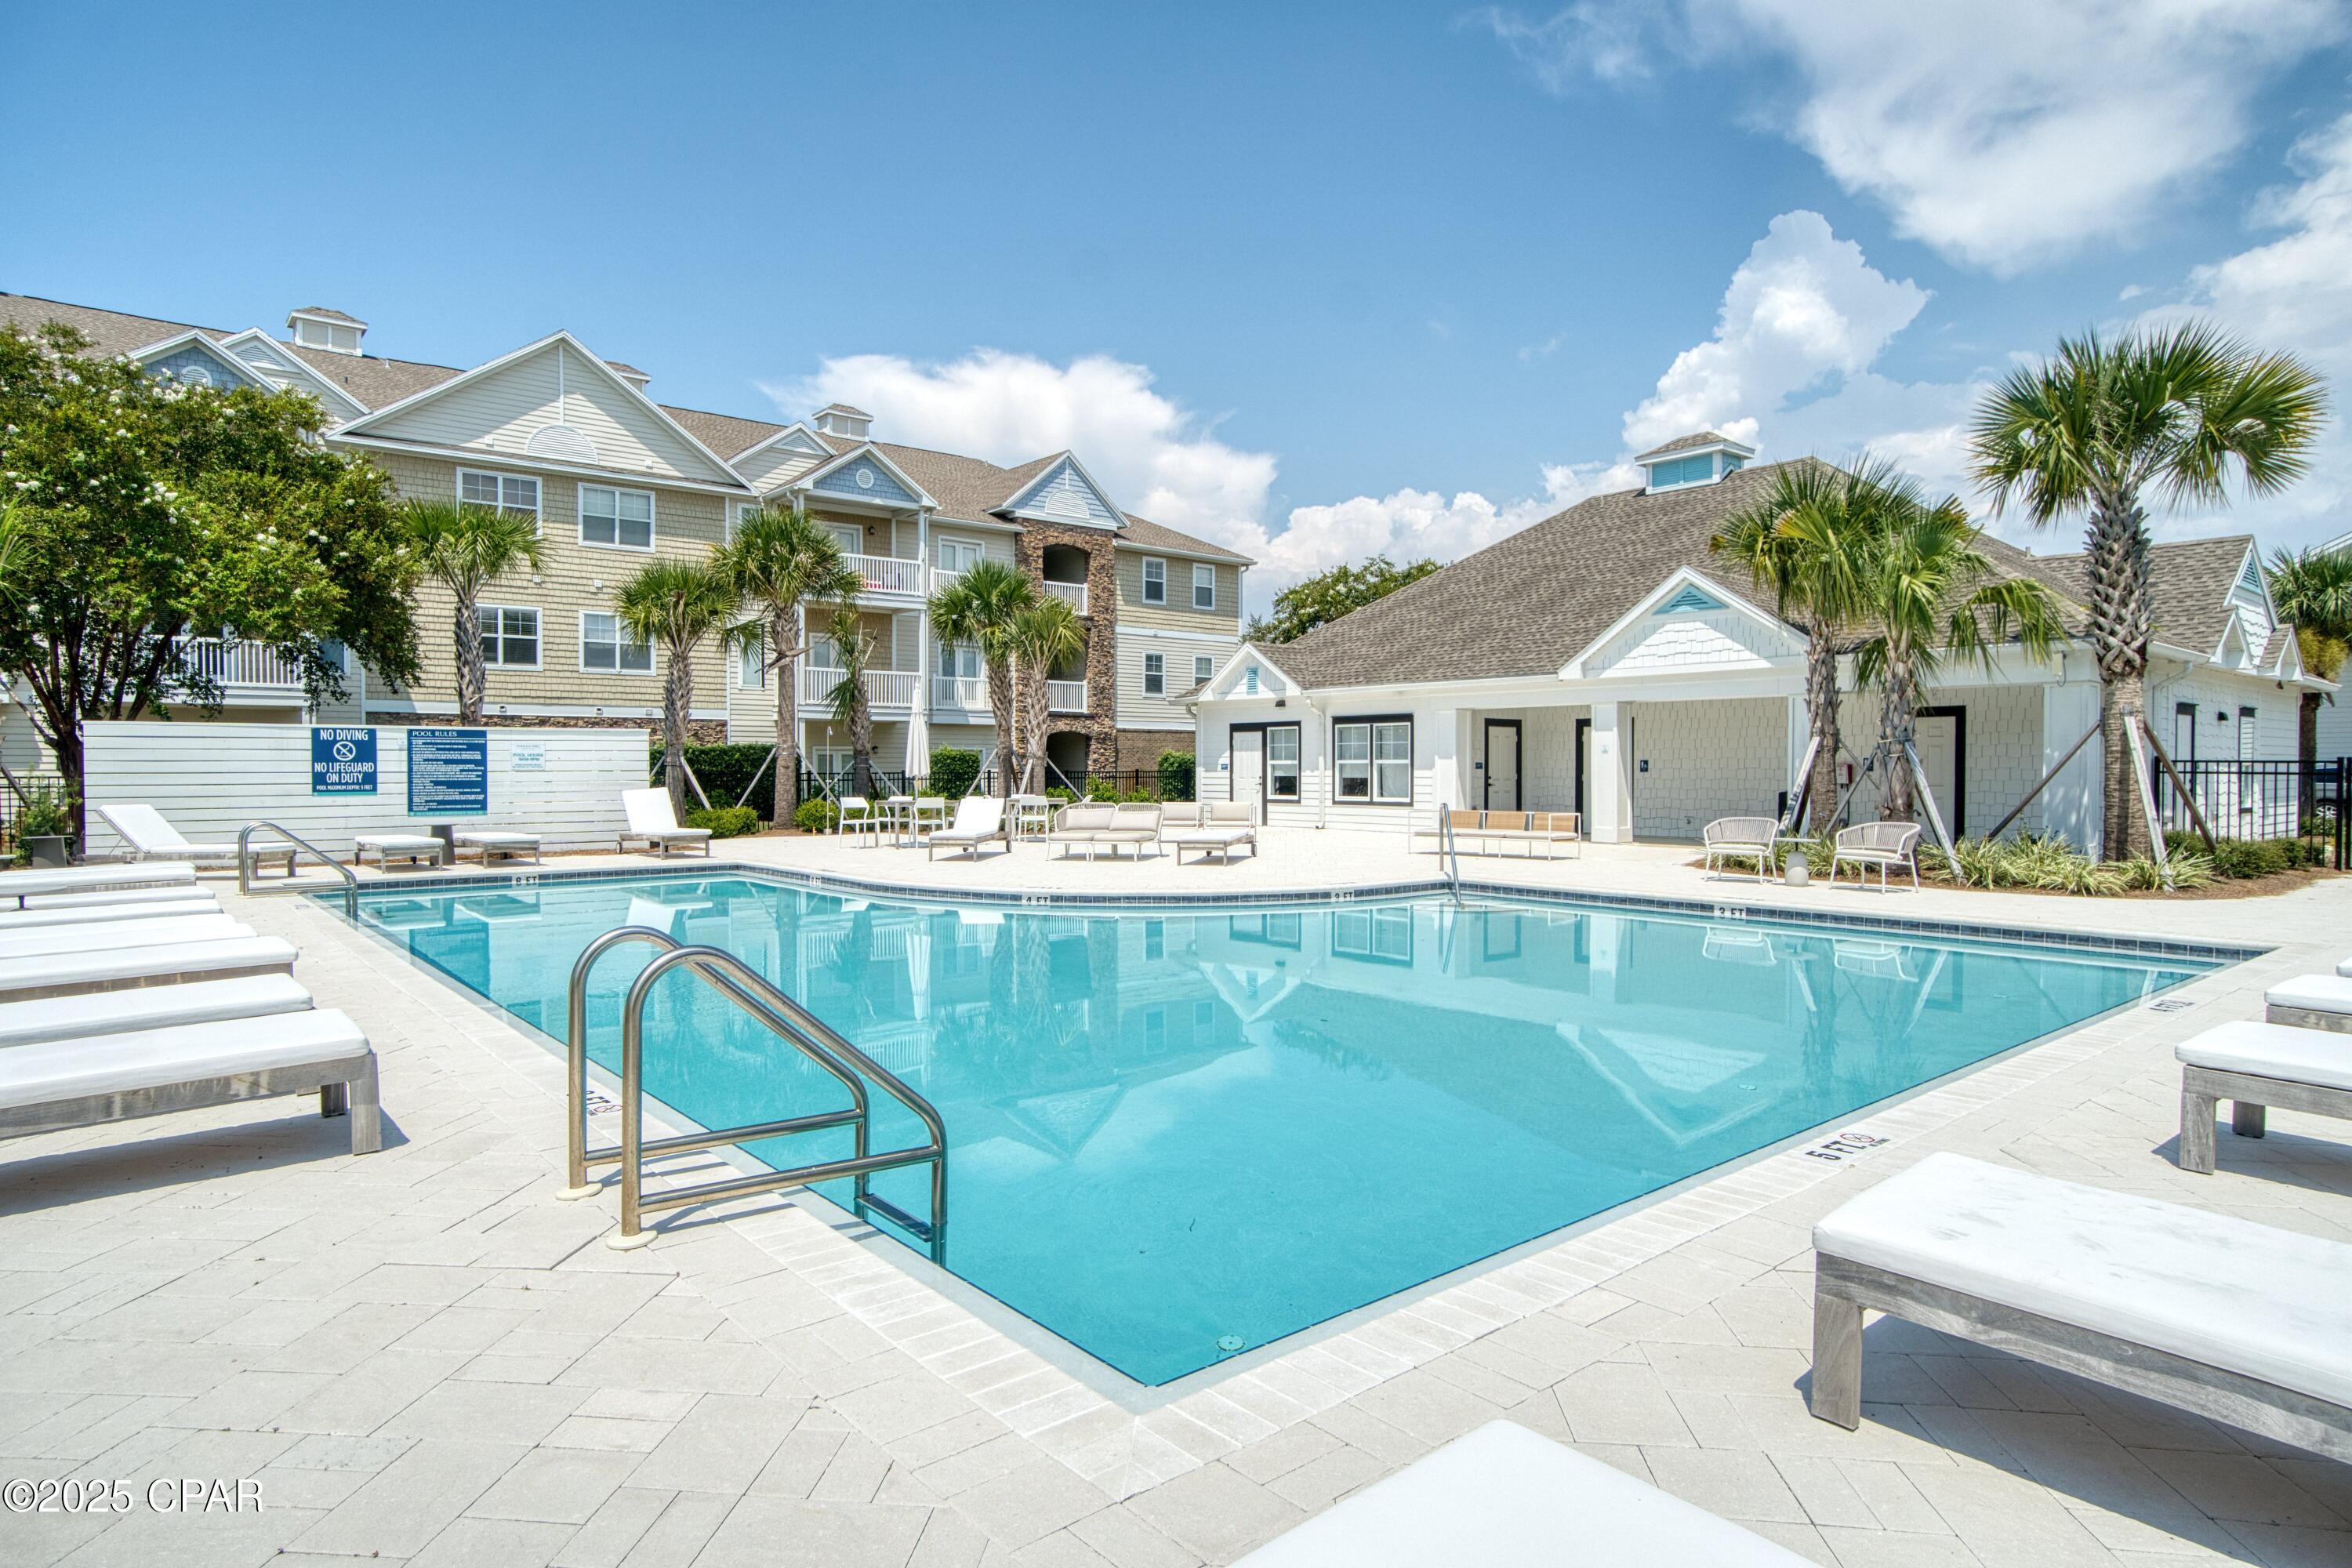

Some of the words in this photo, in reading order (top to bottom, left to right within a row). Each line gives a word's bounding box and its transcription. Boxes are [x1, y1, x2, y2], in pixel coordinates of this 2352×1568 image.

[320, 729, 334, 740] NO
[336, 729, 368, 741] DIVING
[314, 762, 327, 772] NO
[329, 762, 375, 772] LIFEGUARD
[326, 773, 339, 782] ON
[341, 773, 363, 782] DUTY
[1805, 1150, 1842, 1160] 5
